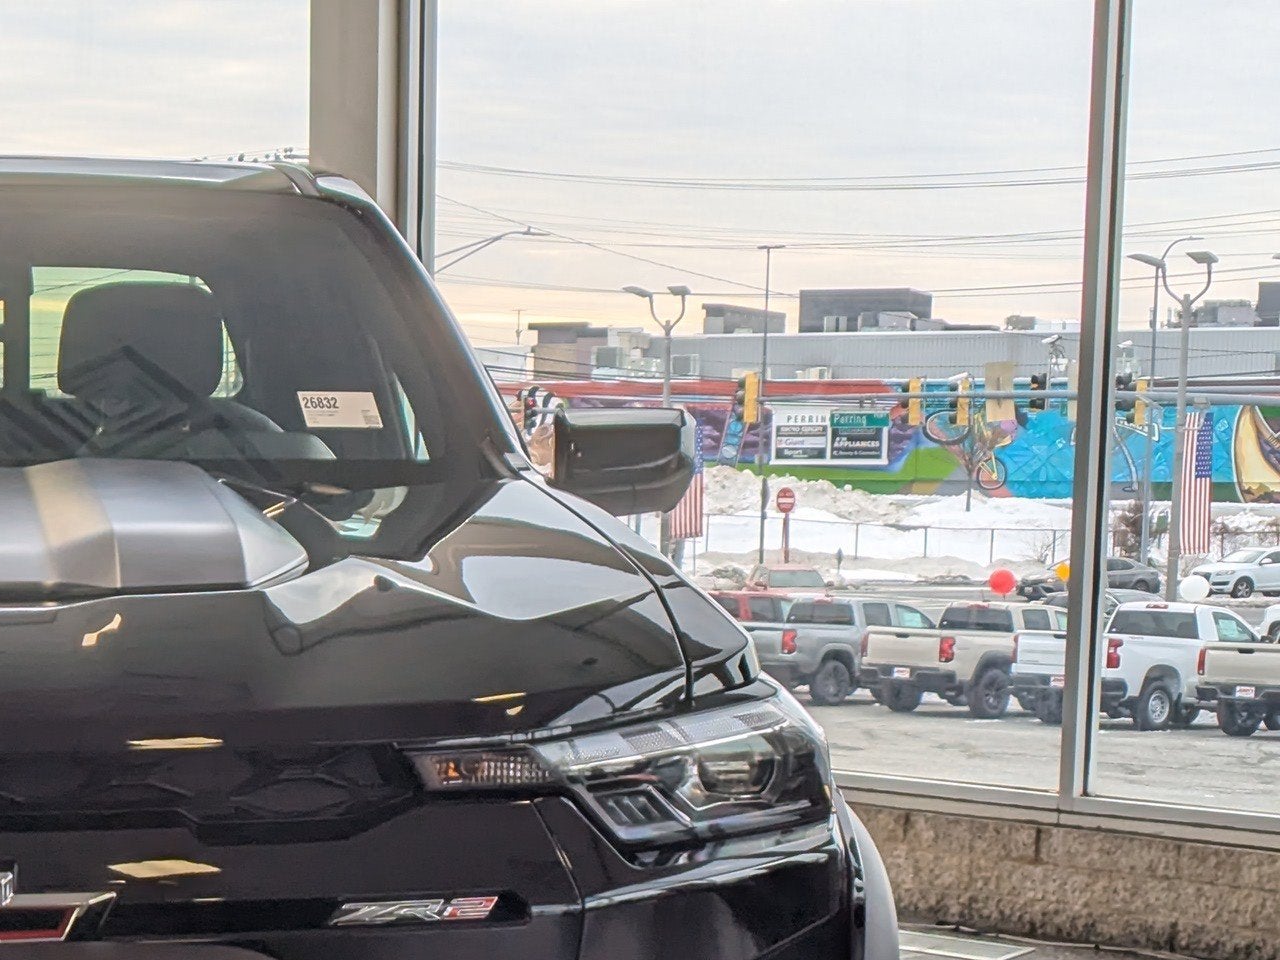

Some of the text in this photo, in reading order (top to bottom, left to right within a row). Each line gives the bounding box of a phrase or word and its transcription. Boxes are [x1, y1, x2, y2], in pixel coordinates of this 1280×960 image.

[302, 396, 340, 409] 26832
[833, 413, 867, 427] Perring
[328, 896, 499, 926] ZR2
